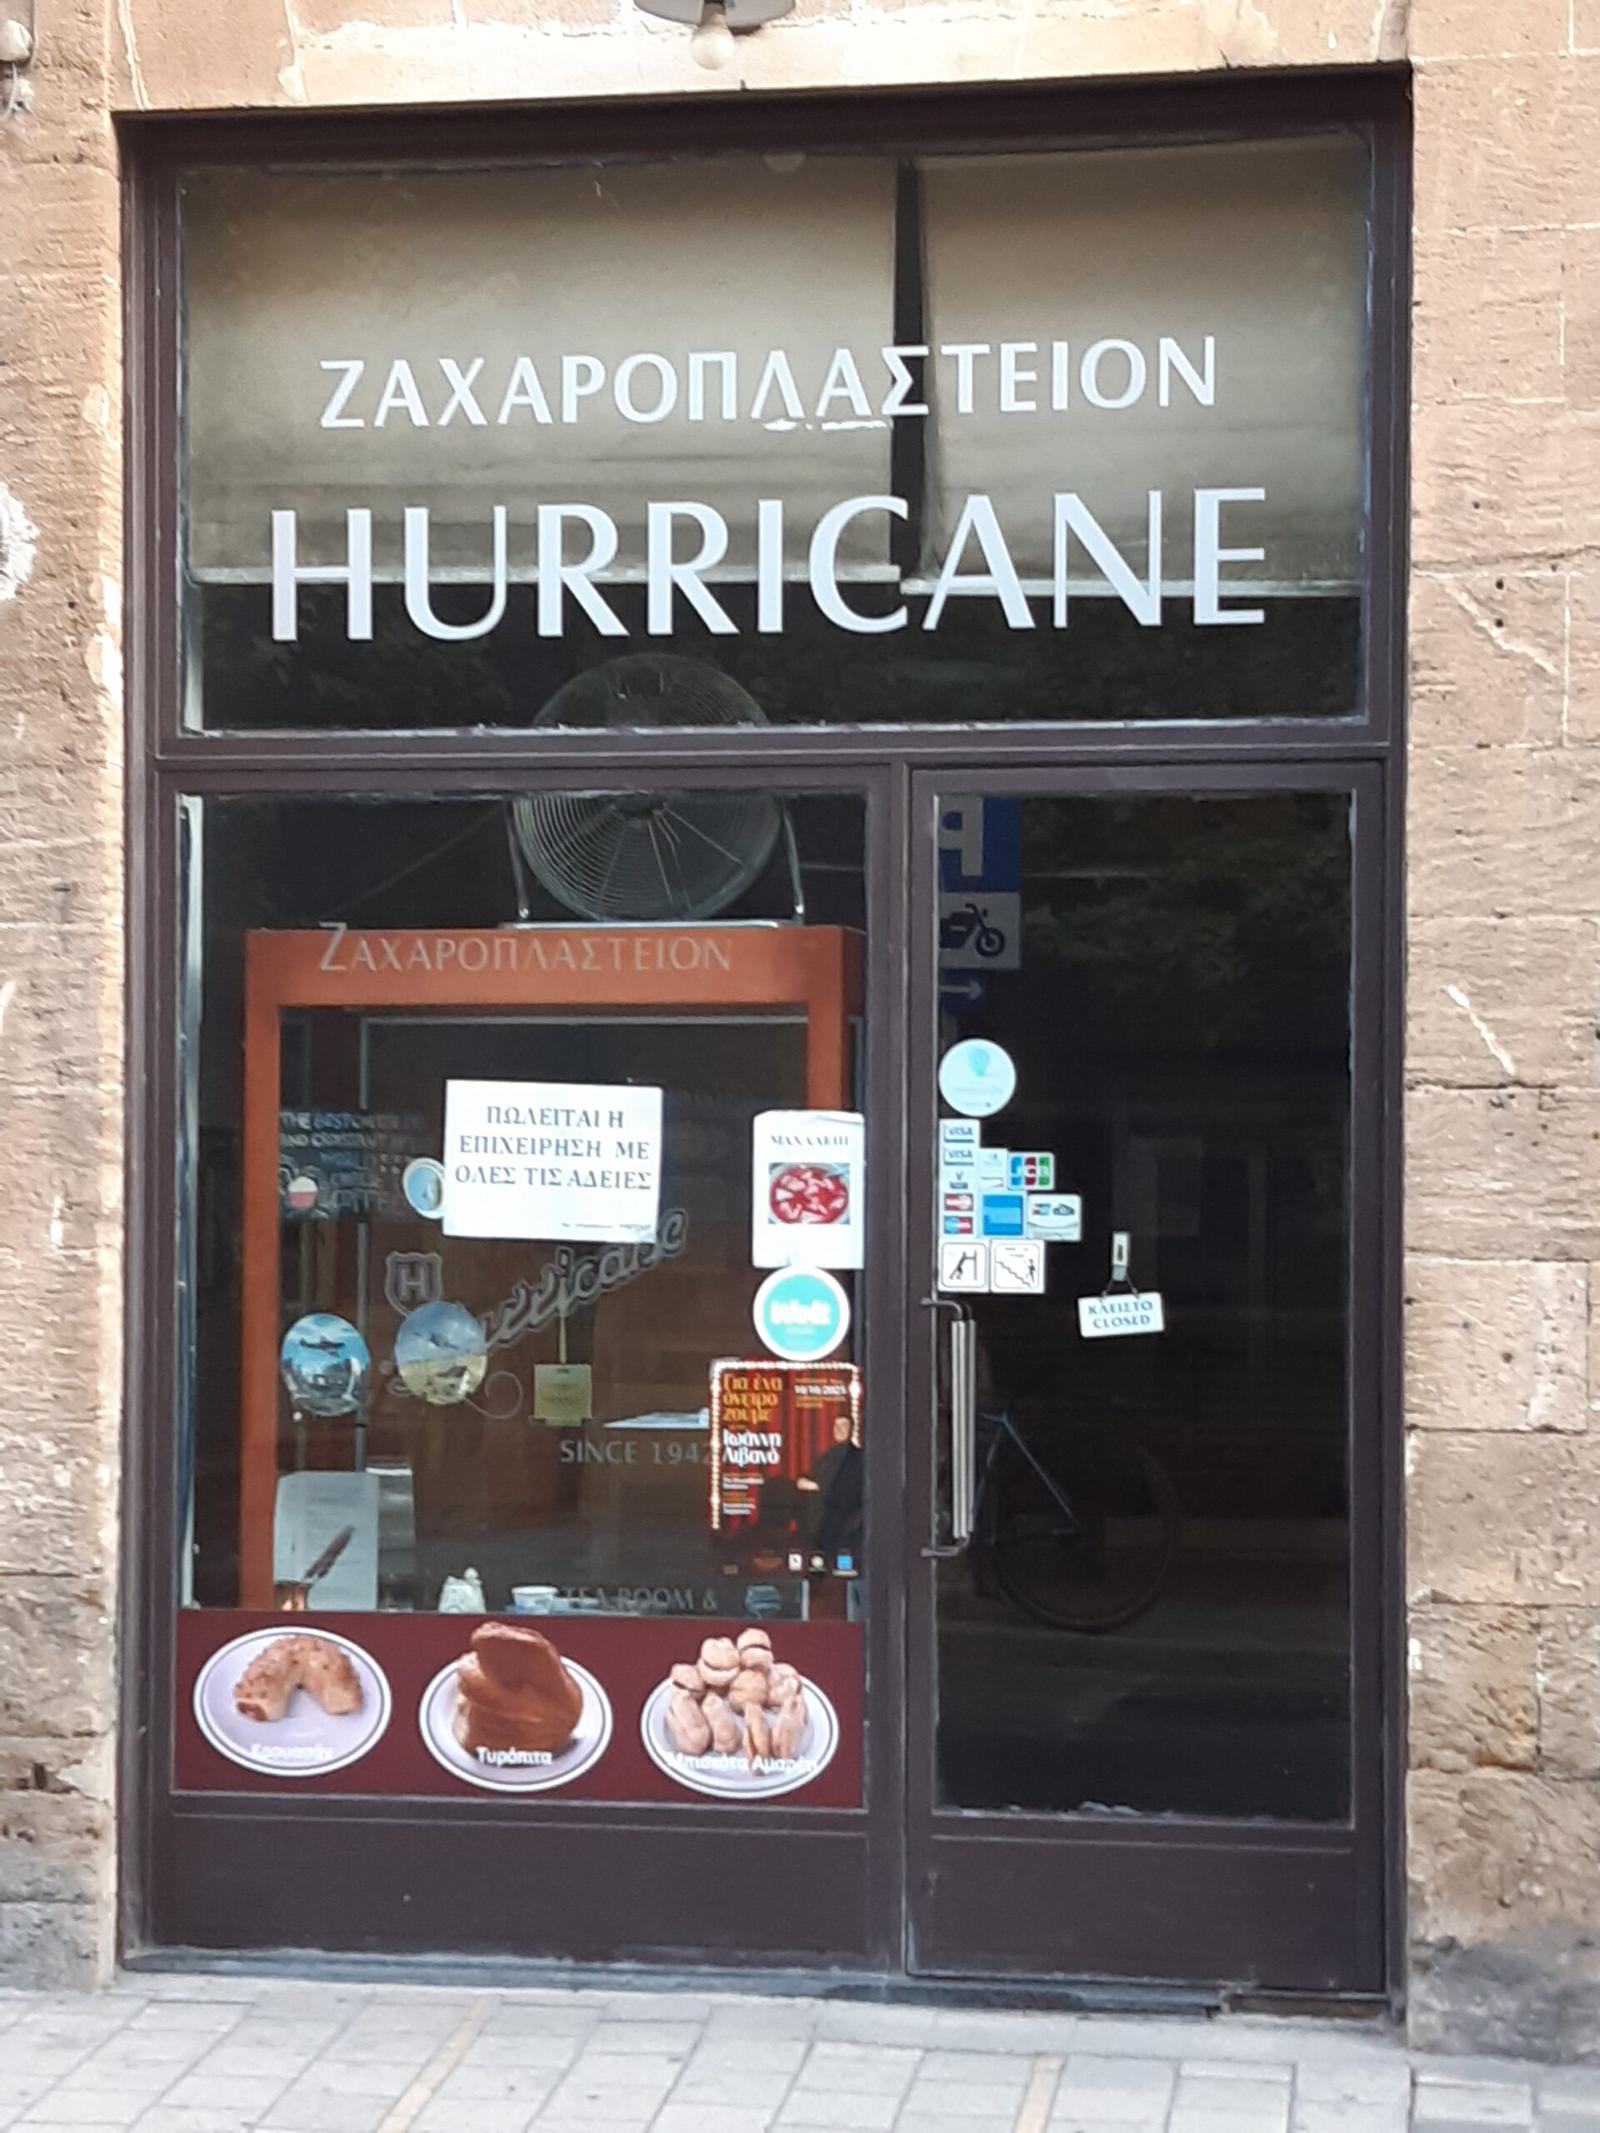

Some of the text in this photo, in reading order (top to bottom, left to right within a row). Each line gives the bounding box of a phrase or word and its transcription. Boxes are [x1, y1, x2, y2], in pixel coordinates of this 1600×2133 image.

[320, 336, 1216, 428] ΖΑΧΑΡΟΠΛΑΣΤΕΙΟΝ
[270, 487, 1266, 641] HURRICANE
[318, 921, 731, 972] ΖΑΧΑΡΟΠΛΑΣΤΕΙΟΝ
[486, 1106, 624, 1129] ΠΩΛΕΙΤΑΙ Η
[459, 1134, 650, 1160] ΕΠΙΧΕΙΡΗΣΗ ΜΕ
[454, 1164, 652, 1190] ΟΛΕΣ ΤΙΣ ΑΔΕΙΕΣ
[399, 1265, 430, 1301] H
[1087, 1301, 1154, 1316] ΚΛΕΙΣΤΟ
[1092, 1314, 1151, 1330] CLOSED
[559, 1439, 638, 1465] SINCE
[617, 1586, 694, 1611] ROOM
[475, 1745, 553, 1768] Τυρόπιτα
